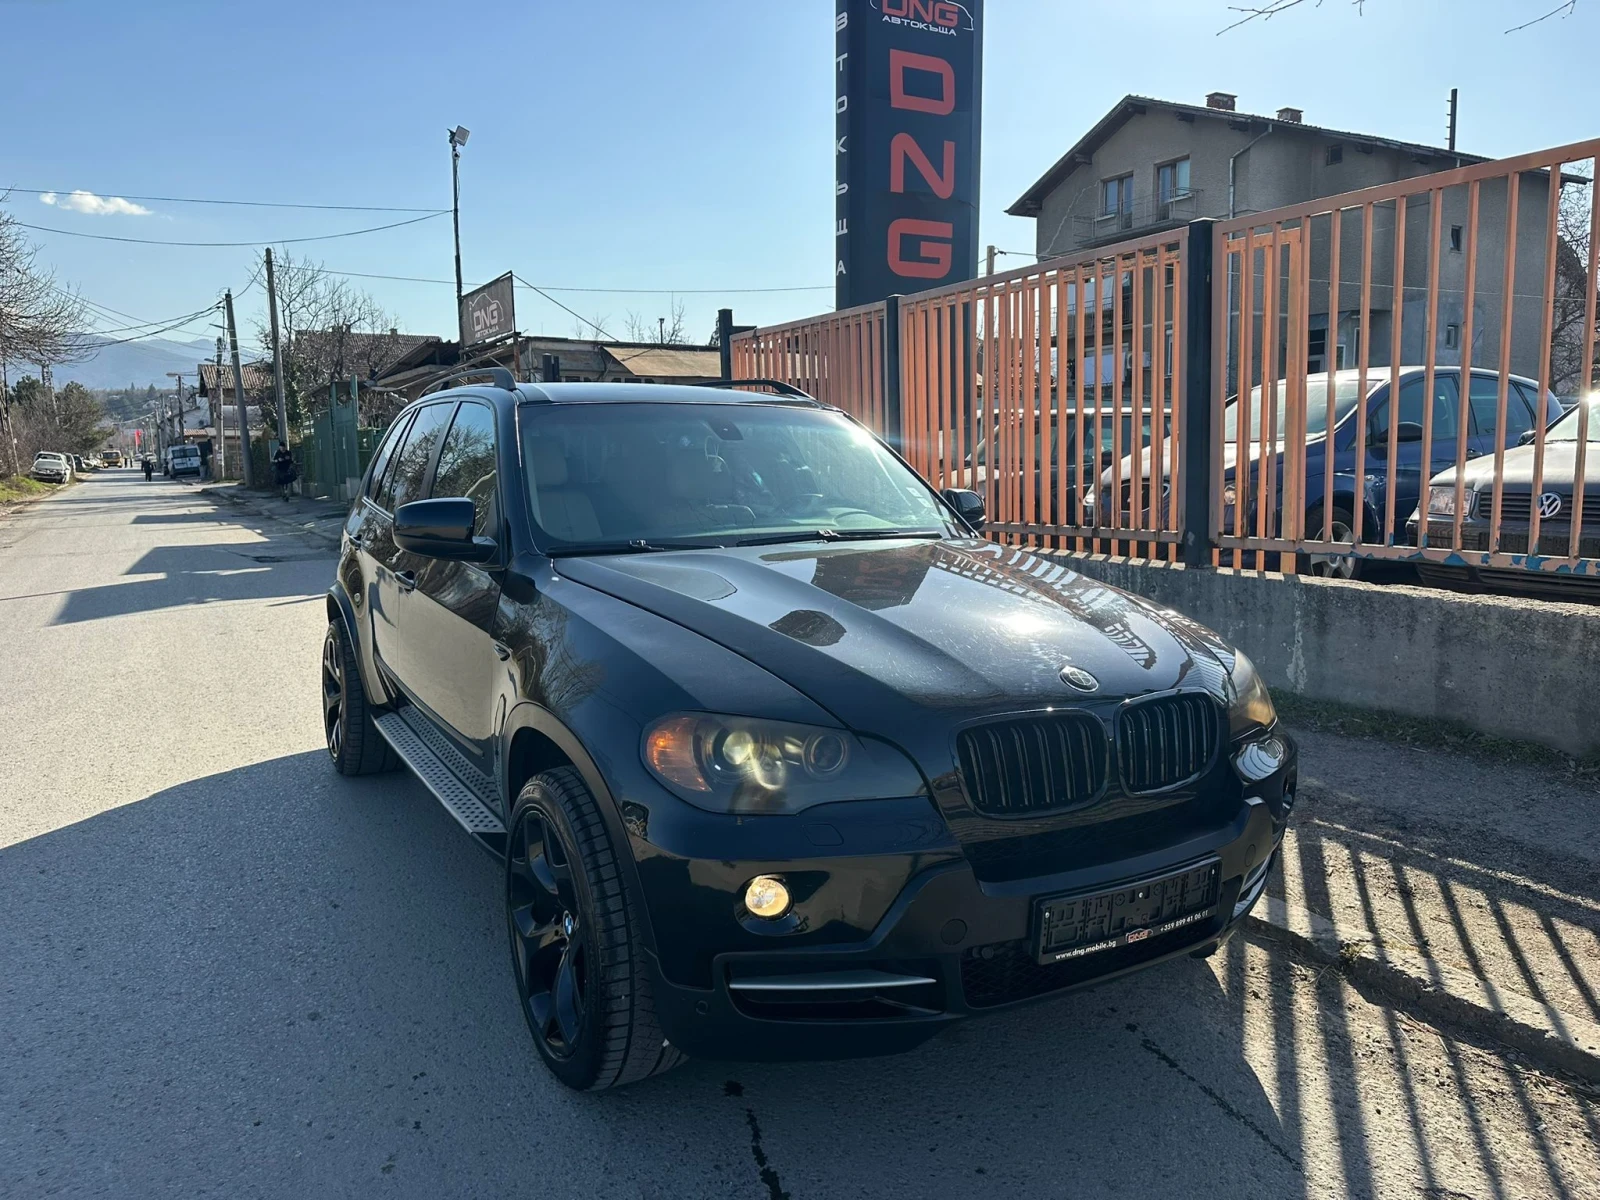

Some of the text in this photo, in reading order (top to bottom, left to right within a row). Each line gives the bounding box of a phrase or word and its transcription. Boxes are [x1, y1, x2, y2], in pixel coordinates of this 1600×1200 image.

[882, 0, 958, 27] DNG
[882, 15, 957, 36] АВТОКЪША
[887, 48, 955, 279] DNG
[473, 303, 498, 331] DNG
[1055, 940, 1117, 960] www.dng.mobile.bg
[1160, 922, 1175, 932] +359
[1175, 918, 1186, 927] 899
